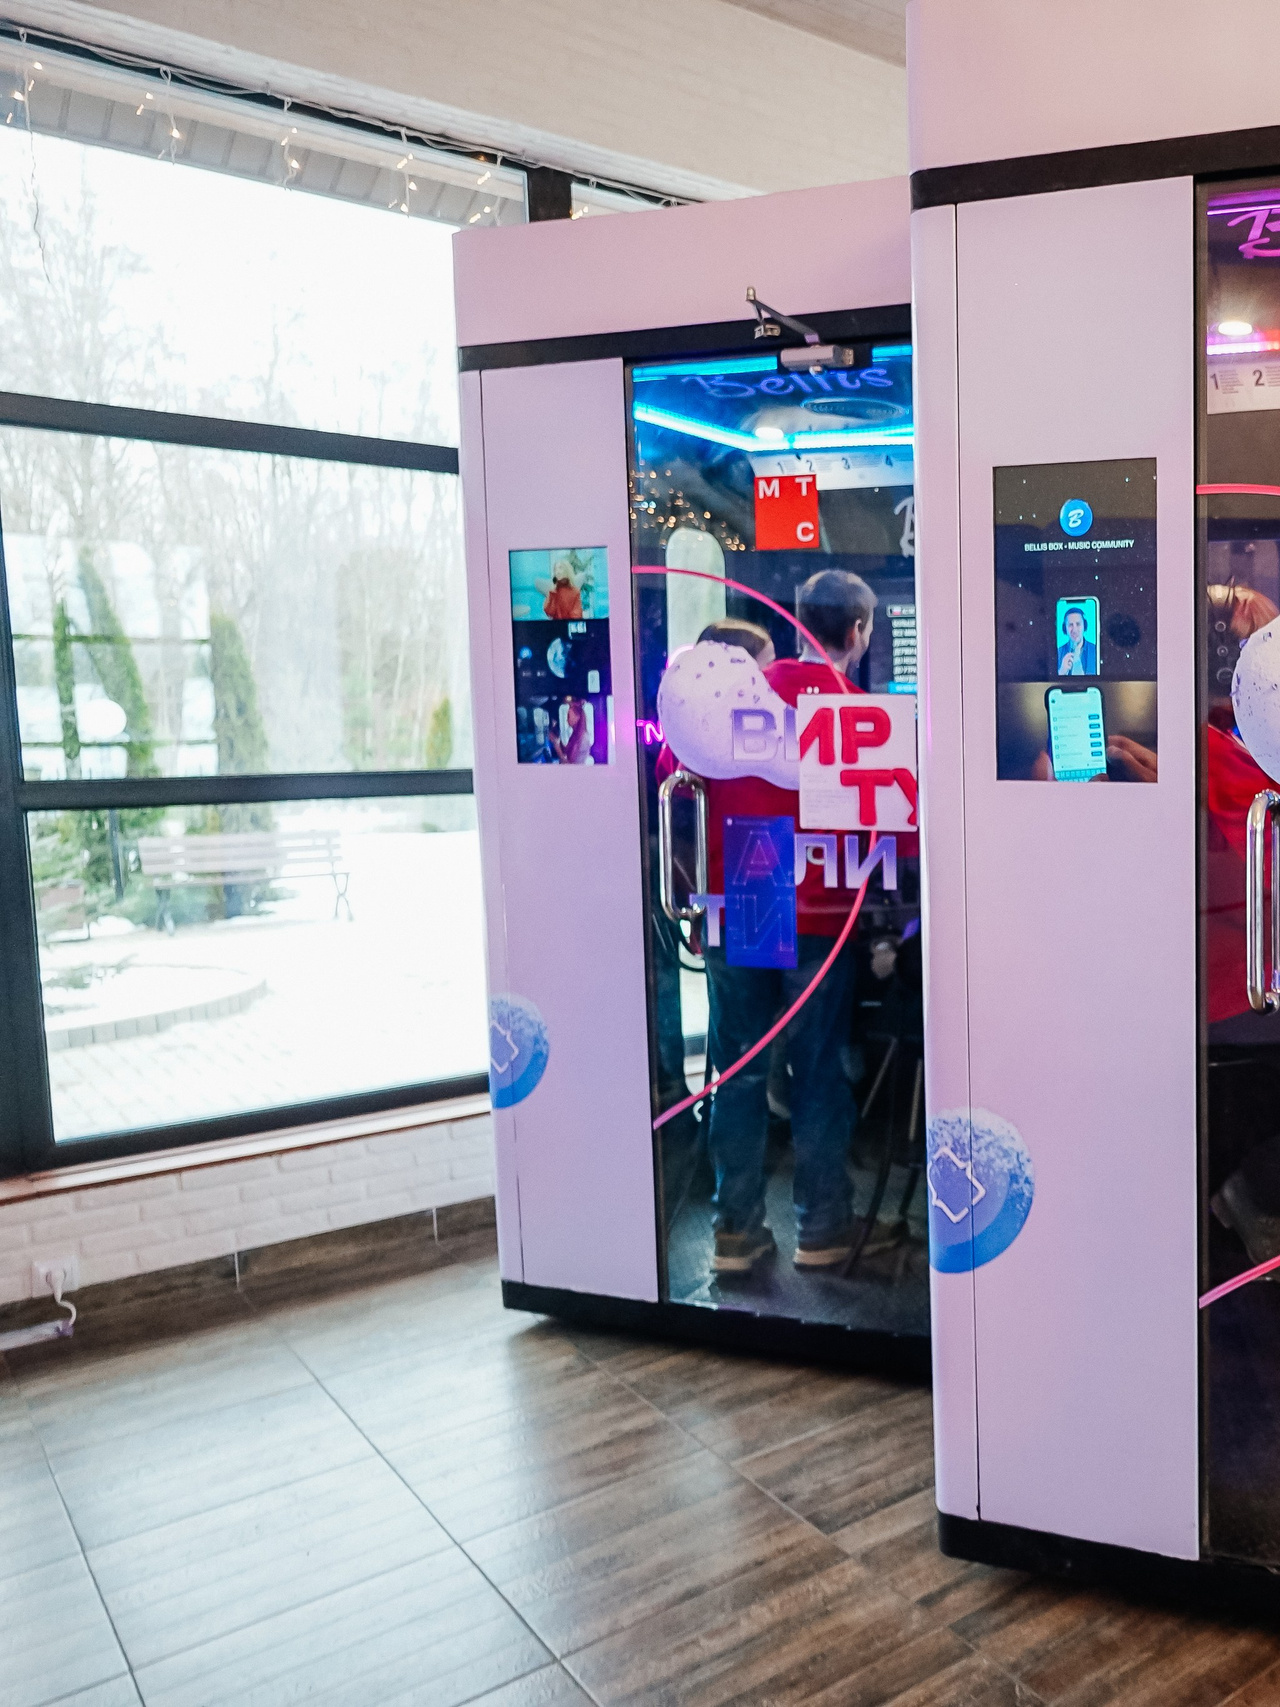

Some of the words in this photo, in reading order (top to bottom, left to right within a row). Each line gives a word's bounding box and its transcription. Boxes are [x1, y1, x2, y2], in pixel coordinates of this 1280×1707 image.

[1210, 373, 1219, 390] 1
[1253, 369, 1265, 387] 2
[1024, 542, 1048, 552] BELLIS
[1049, 541, 1064, 551] BOX
[1068, 540, 1090, 550] MUSIC
[1091, 539, 1135, 550] COMMUNITY
